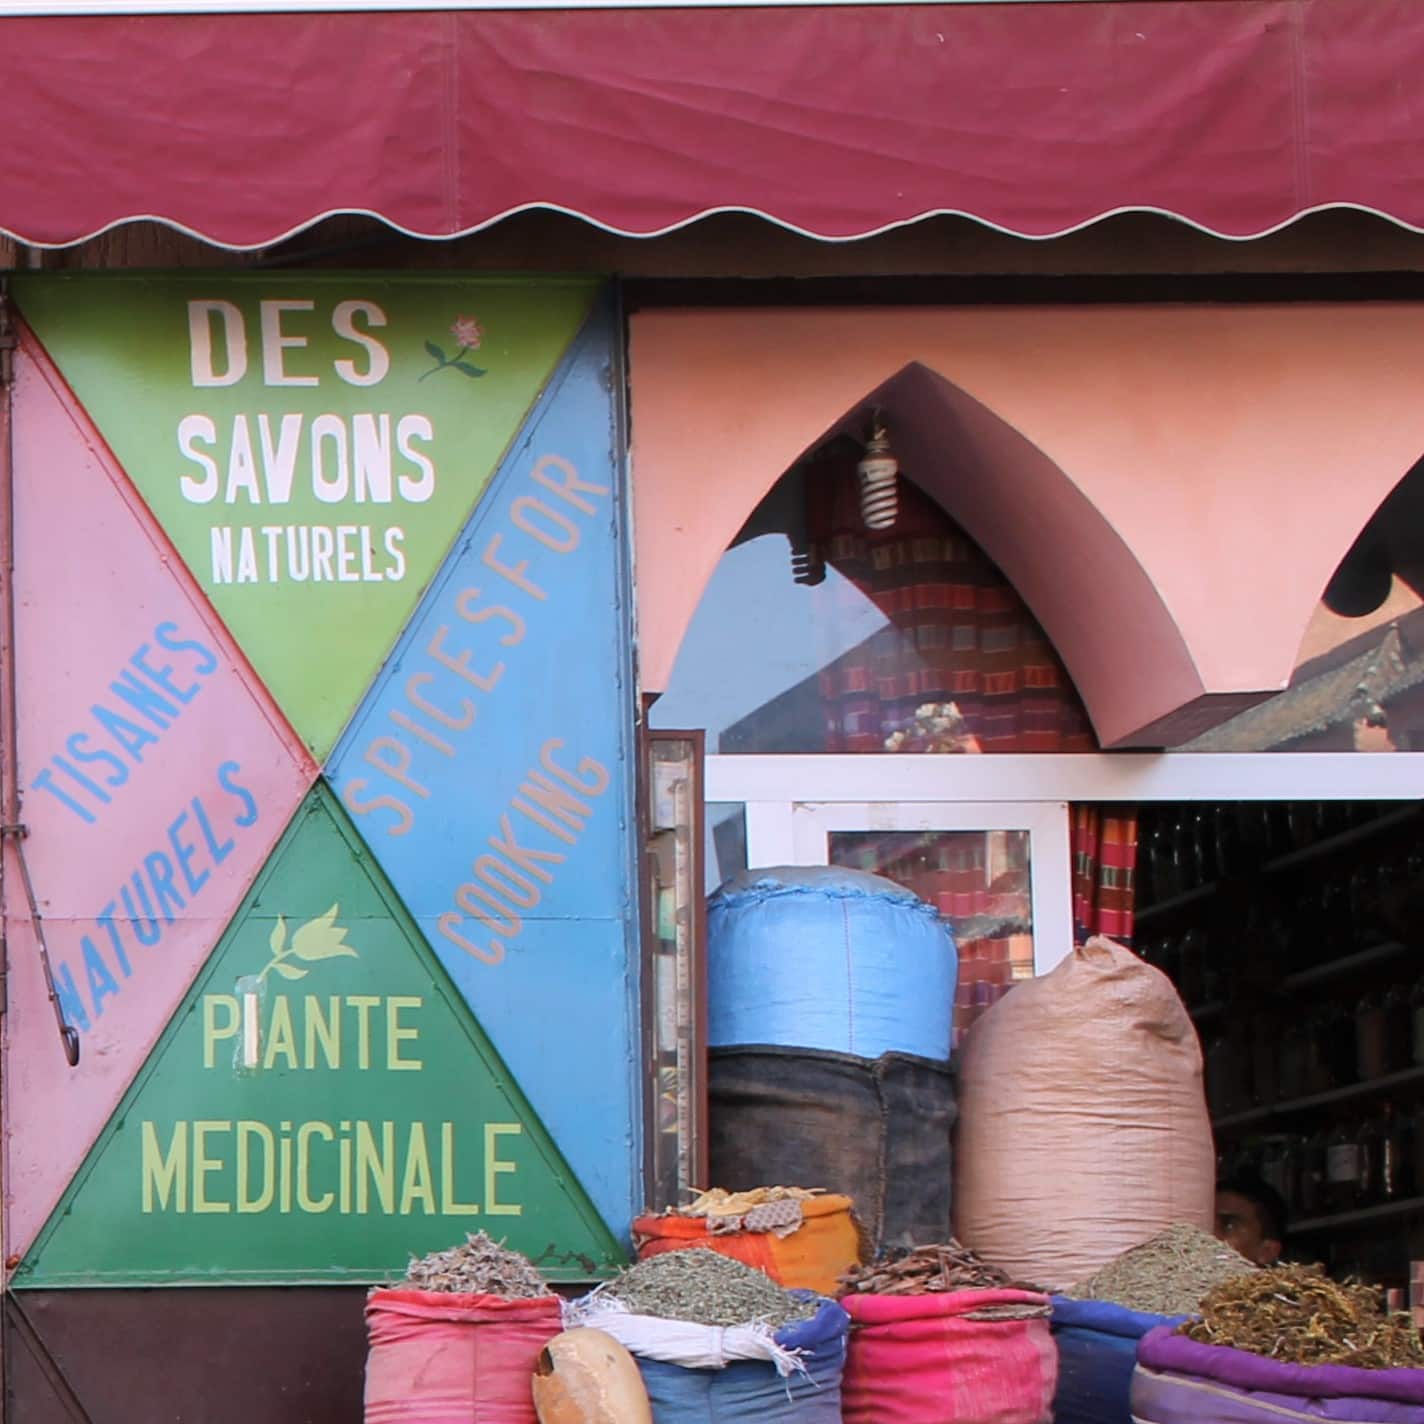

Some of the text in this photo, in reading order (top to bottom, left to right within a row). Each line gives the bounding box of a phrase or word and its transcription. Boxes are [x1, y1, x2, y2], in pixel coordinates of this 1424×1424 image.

[186, 298, 391, 389] DES
[177, 413, 435, 505] SAVONS
[210, 525, 407, 585] NATURELS
[30, 620, 219, 825] TISANES
[342, 451, 611, 837] SPICES FOR
[52, 760, 259, 1034] NATURELS
[436, 737, 611, 967] COOKING
